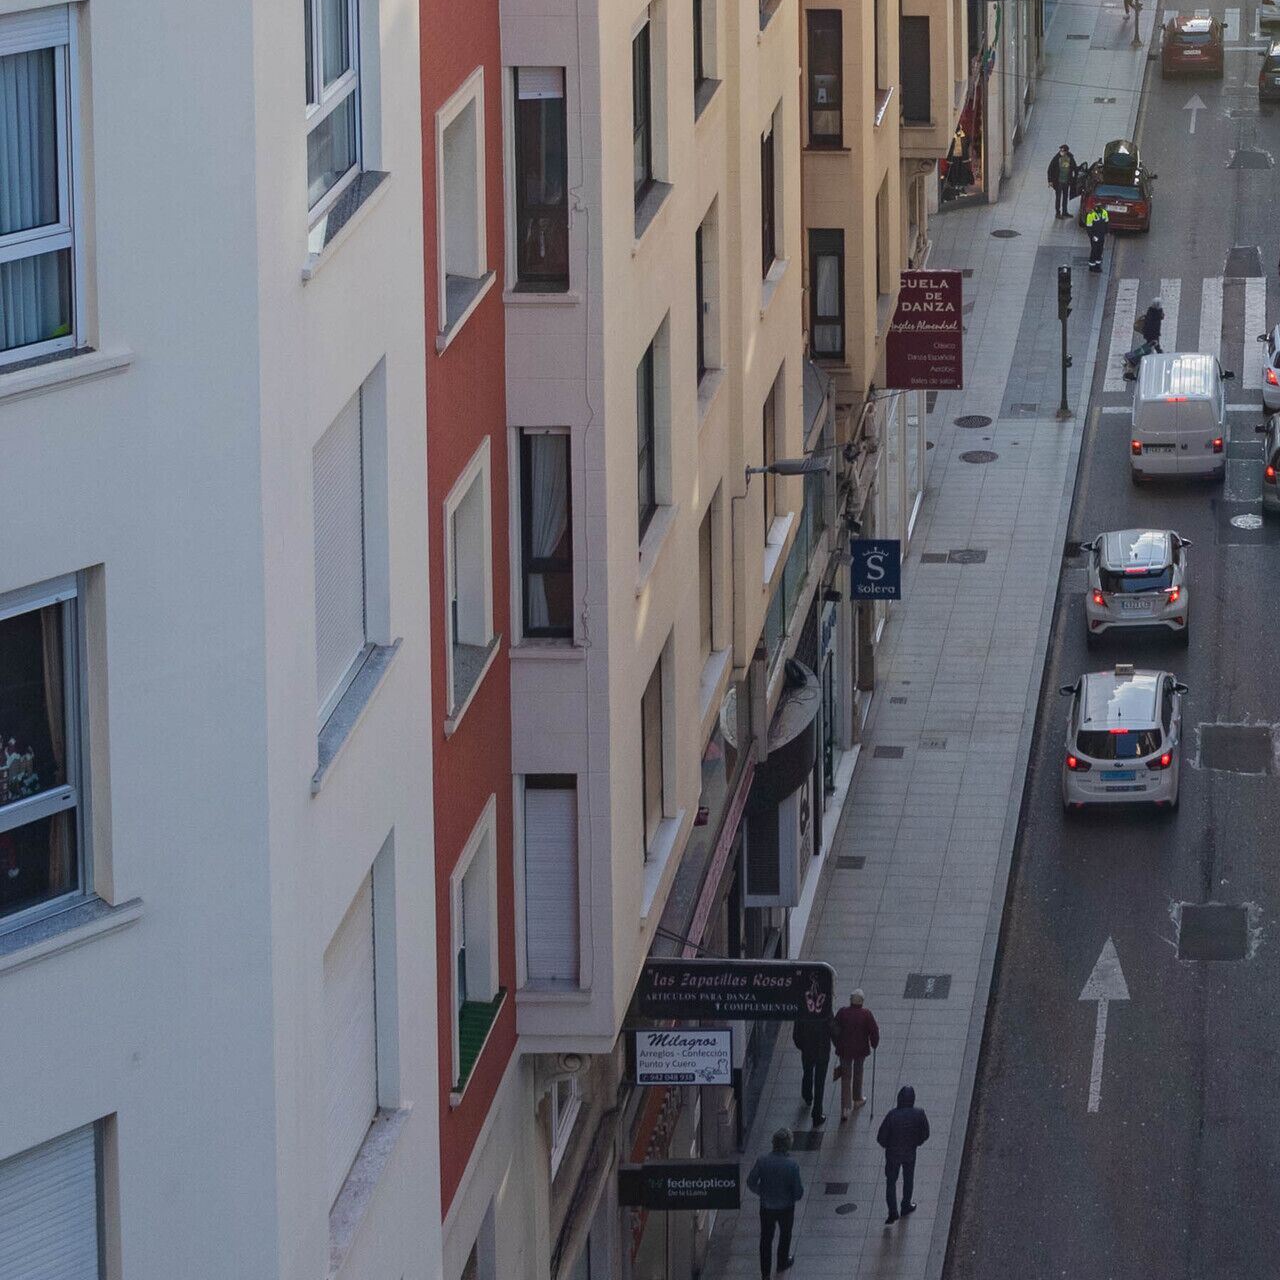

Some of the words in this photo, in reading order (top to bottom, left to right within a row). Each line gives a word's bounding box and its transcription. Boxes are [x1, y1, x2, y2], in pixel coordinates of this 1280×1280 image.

[925, 292, 943, 300] DE
[901, 302, 955, 312] DANZA
[867, 555, 885, 580] S
[680, 973, 747, 989] Zapatillas
[699, 993, 723, 1001] PARA
[726, 993, 757, 1001] DANZA
[724, 1004, 799, 1012] COMPLEMENTOS
[648, 1033, 717, 1050] Milagros
[639, 1049, 675, 1058] Arreglos
[639, 1060, 664, 1068] Punto
[672, 1059, 697, 1068] Cuero
[667, 1177, 736, 1189] federópticos
